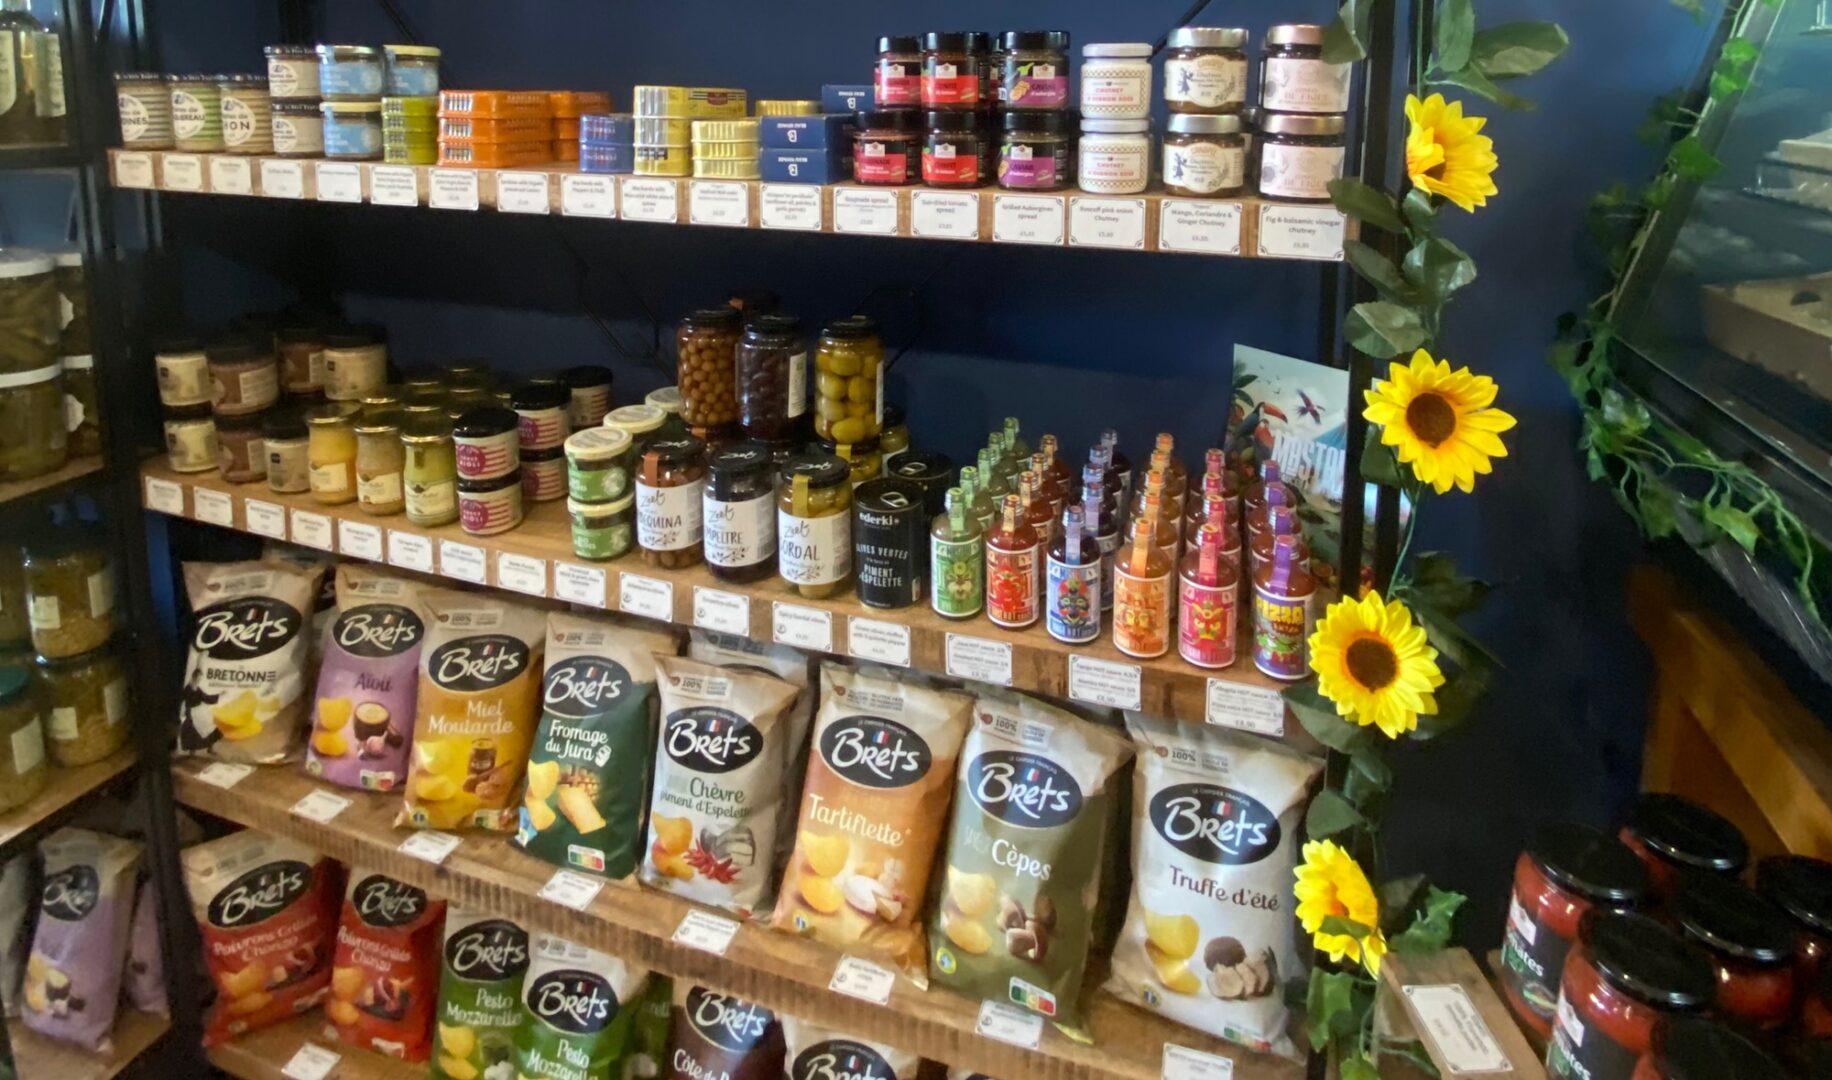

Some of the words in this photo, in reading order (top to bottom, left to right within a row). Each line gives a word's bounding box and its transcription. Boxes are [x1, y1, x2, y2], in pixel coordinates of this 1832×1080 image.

[1094, 215, 1119, 225] Chutney
[1177, 219, 1198, 228] Ginger
[1199, 220, 1226, 229] Chutney
[1266, 216, 1275, 225] Fig
[1284, 217, 1314, 225] balsamic
[1315, 219, 1341, 229] vinegar
[1288, 227, 1316, 236] chutney
[782, 540, 820, 561] ORDAL
[878, 546, 909, 560] VERTES
[864, 564, 893, 578] PIMENT
[195, 611, 289, 650] Brets
[340, 614, 416, 651] Brets
[206, 668, 276, 682] BRETONNE
[438, 648, 520, 682] Brets
[544, 667, 623, 708] Brets
[466, 699, 504, 718] Miel
[428, 714, 514, 734] Moutarde
[549, 719, 608, 746] Fromage
[545, 739, 561, 754] du
[560, 742, 594, 762] Jura
[668, 719, 752, 766] Brets
[831, 727, 920, 780] Brets
[689, 776, 745, 804] Chèvre
[977, 762, 1070, 819] Brets
[809, 793, 904, 845] Tartiflette
[1165, 796, 1268, 856] Brets
[992, 839, 1051, 881] Cèpes
[221, 871, 304, 925] Brets
[1169, 865, 1229, 901] Truffe
[1233, 887, 1279, 912] d'été
[454, 932, 526, 973] Brets
[475, 988, 514, 1008] Pesto
[538, 981, 608, 1027] Brets
[695, 990, 766, 1042] Brets
[557, 1039, 590, 1068] Pesto
[673, 1049, 702, 1079] Côte
